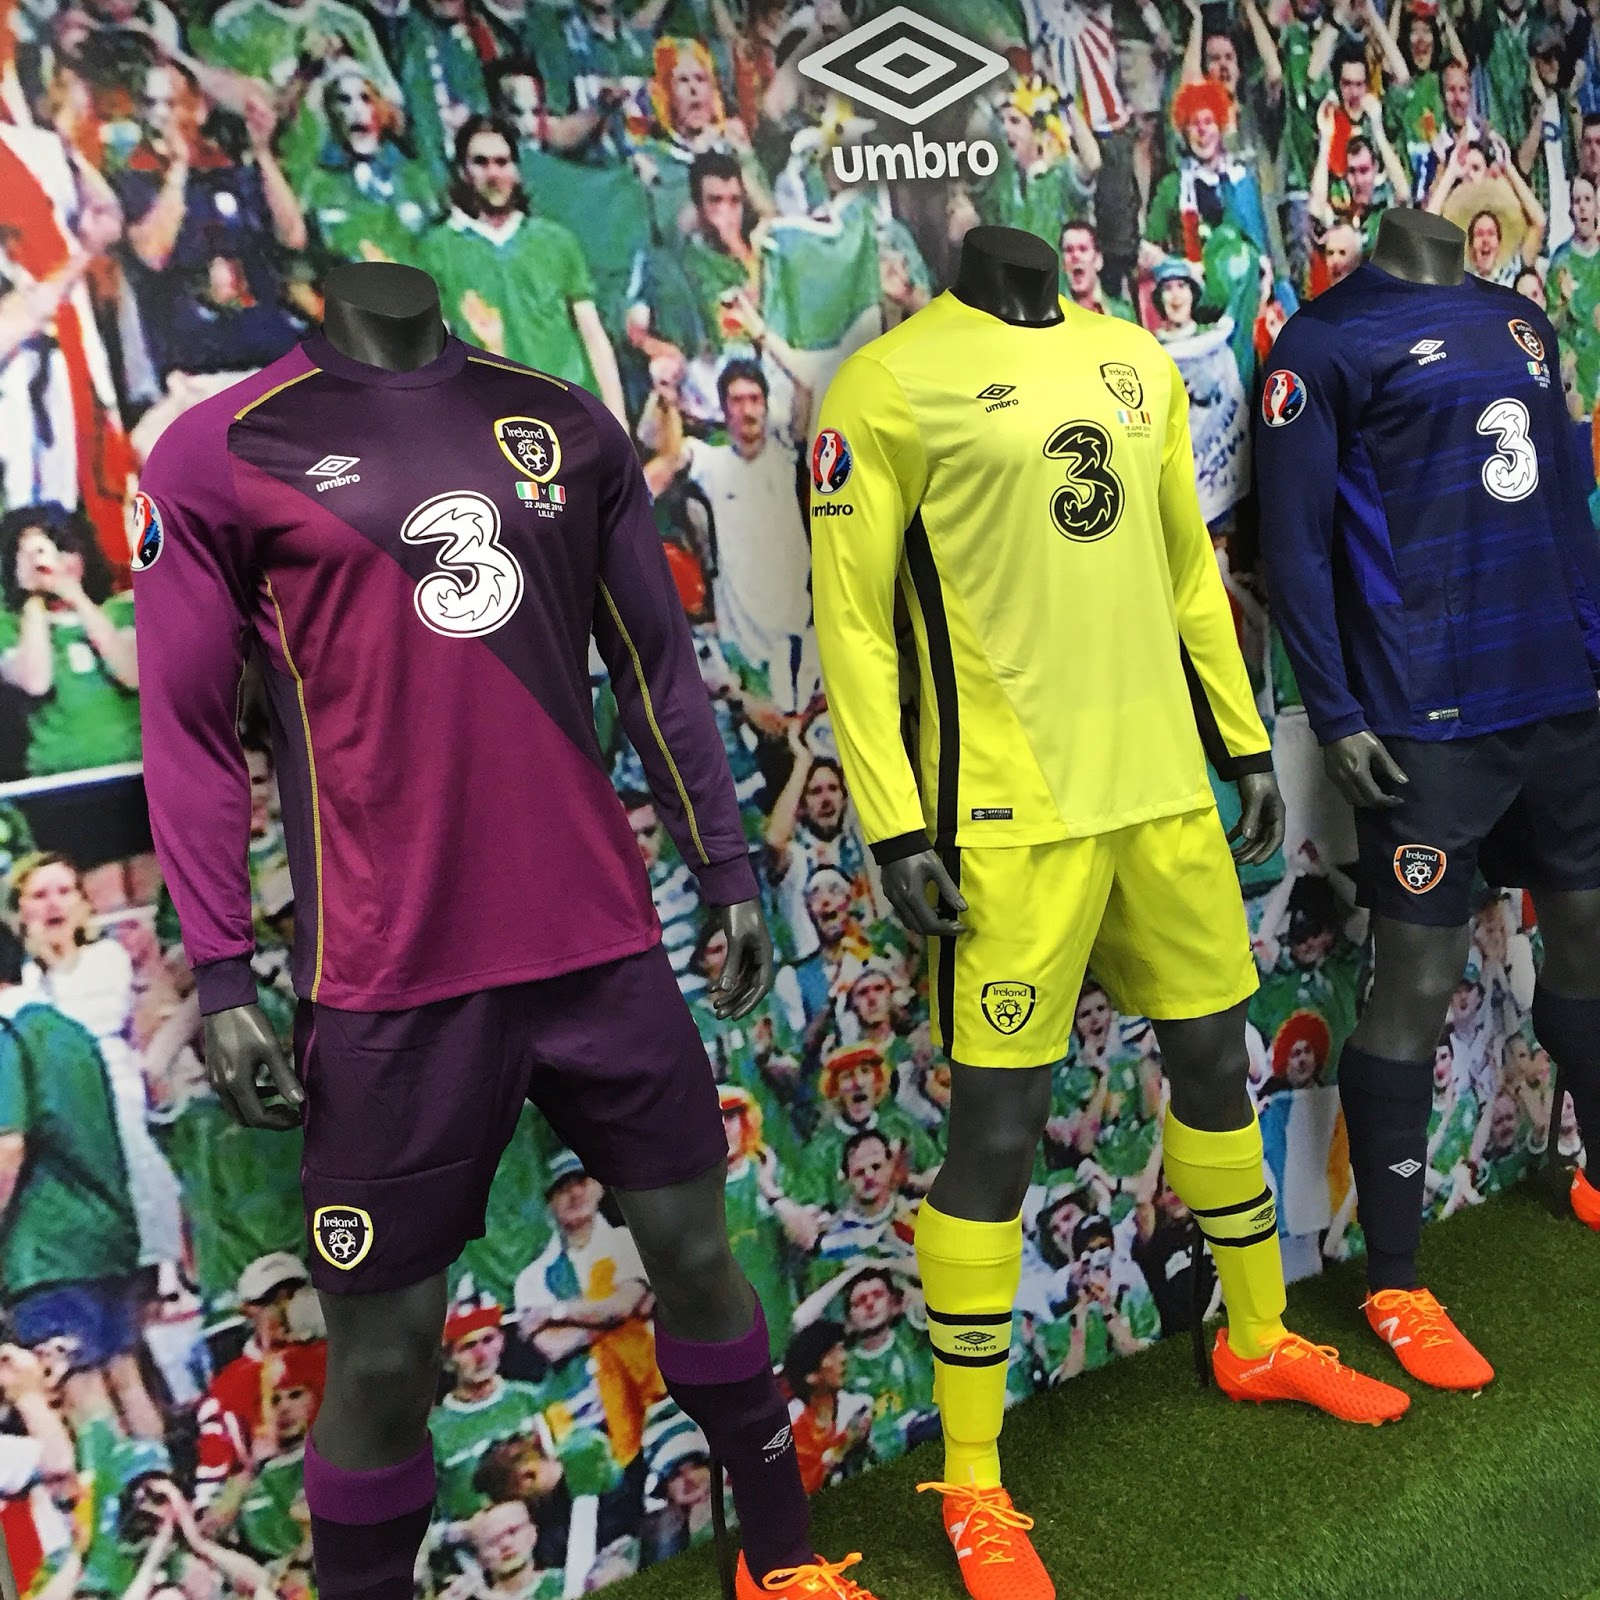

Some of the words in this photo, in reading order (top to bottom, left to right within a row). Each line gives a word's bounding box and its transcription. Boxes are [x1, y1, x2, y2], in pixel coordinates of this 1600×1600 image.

[832, 131, 998, 183] umbro
[1418, 352, 1447, 365] umbro
[985, 399, 1019, 413] umbro
[504, 425, 544, 440] Ireland
[1476, 398, 1539, 502] 3
[315, 474, 361, 492] umbro
[1042, 419, 1125, 542] 3
[524, 501, 534, 509] 22
[534, 502, 551, 510] JUNE
[538, 510, 555, 519] LILLE
[400, 490, 524, 638] 3
[1405, 850, 1438, 862] Ireland
[992, 986, 1027, 997] Ireland
[322, 1215, 359, 1228] Ireland
[954, 1344, 997, 1352] umbro
